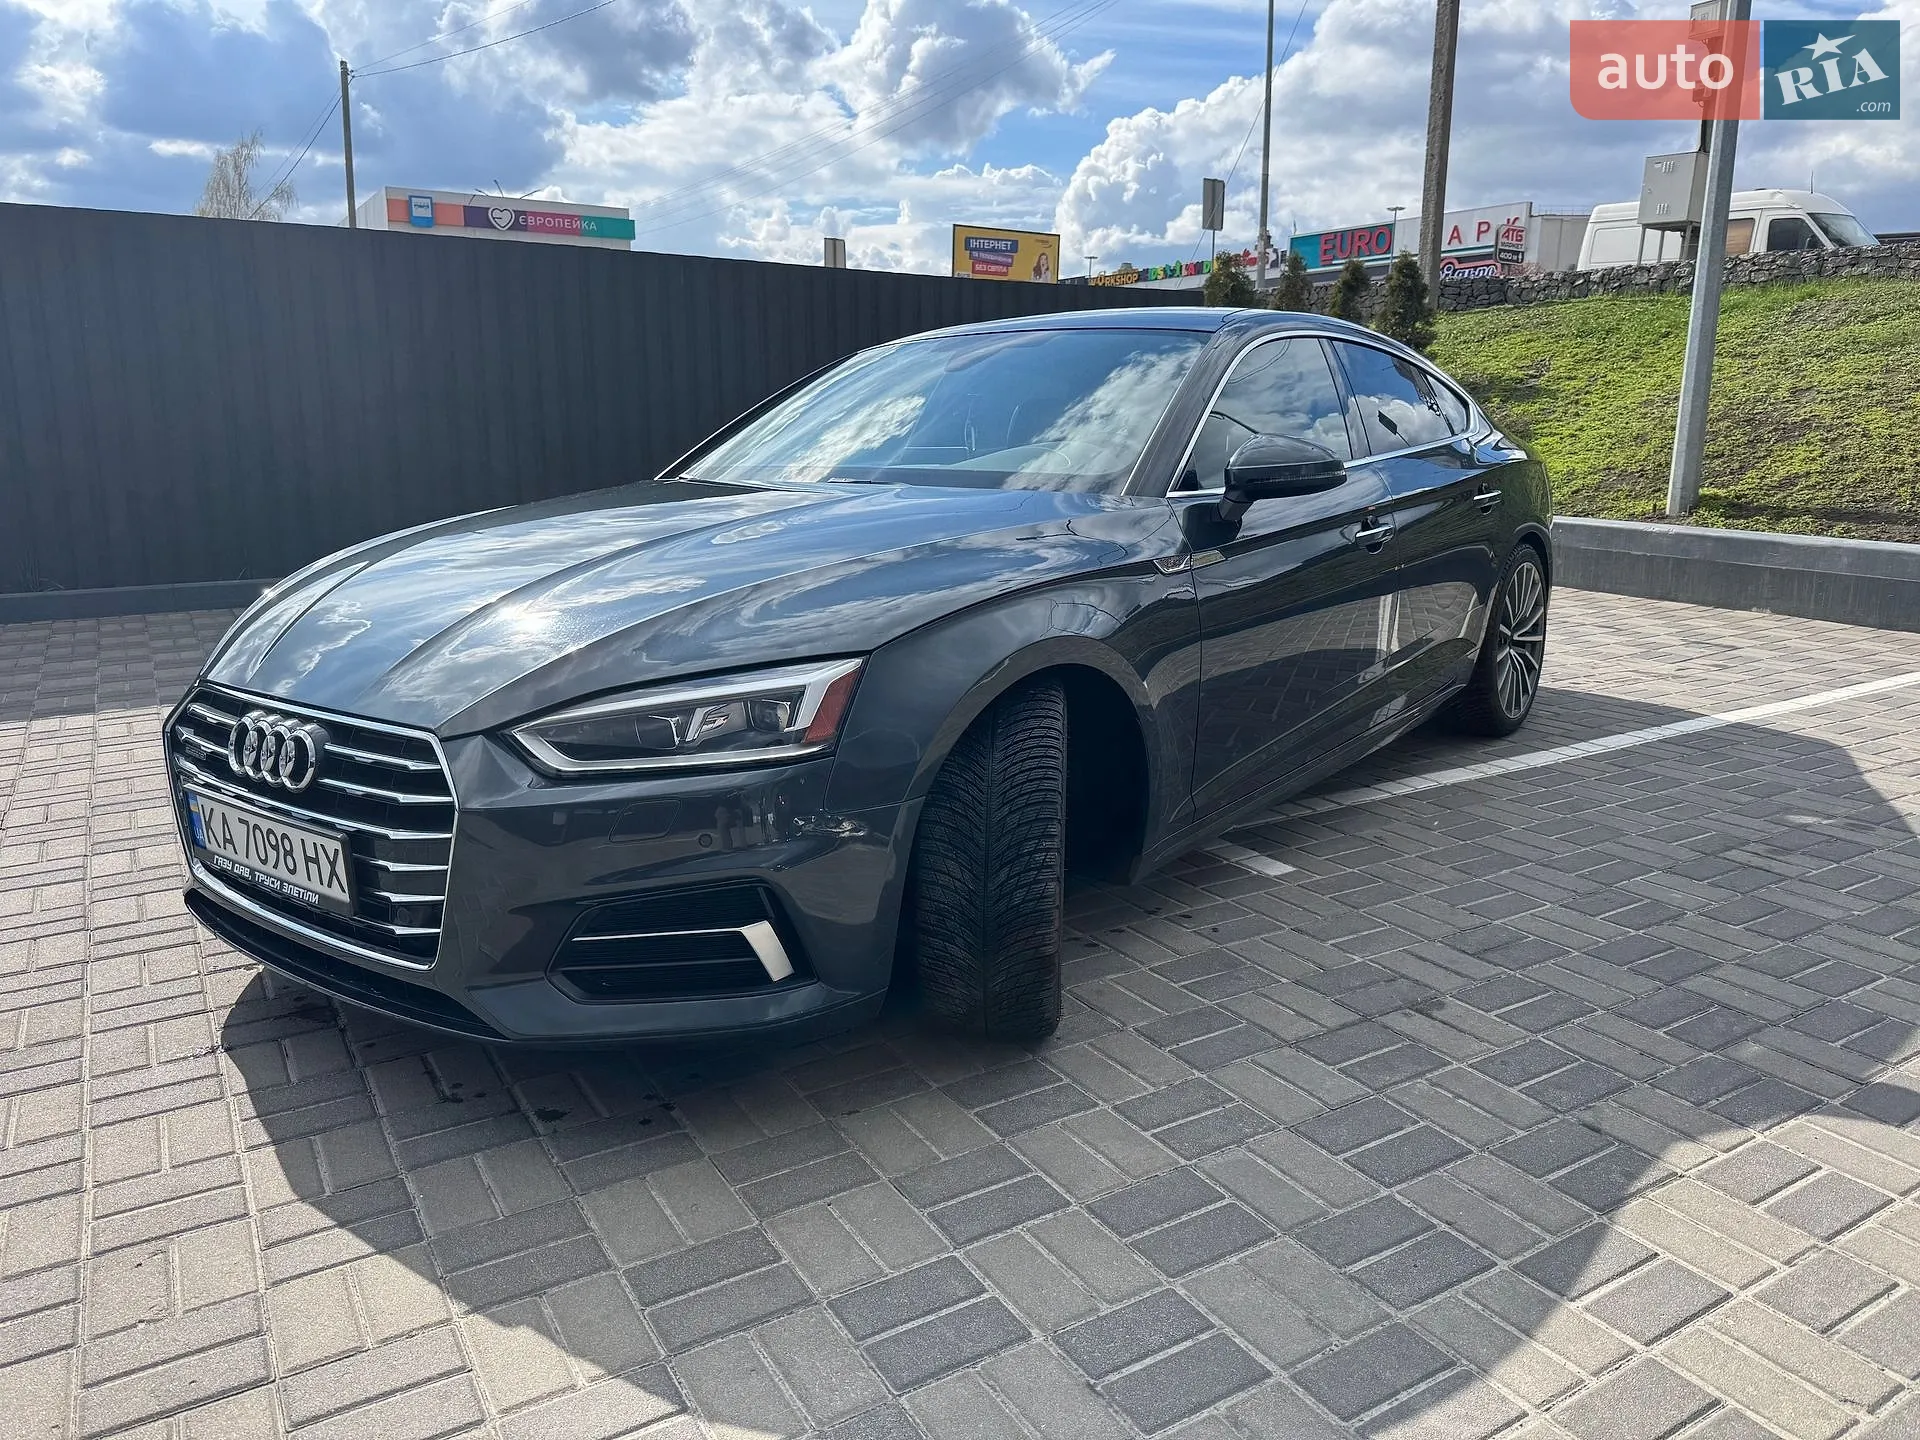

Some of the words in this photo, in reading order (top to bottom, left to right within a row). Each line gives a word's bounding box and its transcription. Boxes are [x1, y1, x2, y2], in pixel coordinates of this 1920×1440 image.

[518, 215, 598, 231] ЄВРОПЕЙКА
[970, 239, 1012, 250] ІНТЕРНЕТ
[1319, 226, 1392, 265] EURO
[195, 828, 206, 841] UA
[201, 804, 238, 857] KA
[237, 816, 297, 876] 7098
[300, 837, 347, 894] HX
[213, 855, 233, 871] ГАЗУ
[254, 871, 281, 891] ТРУСИ
[282, 883, 320, 905] ЗЛЕТІЛИ
